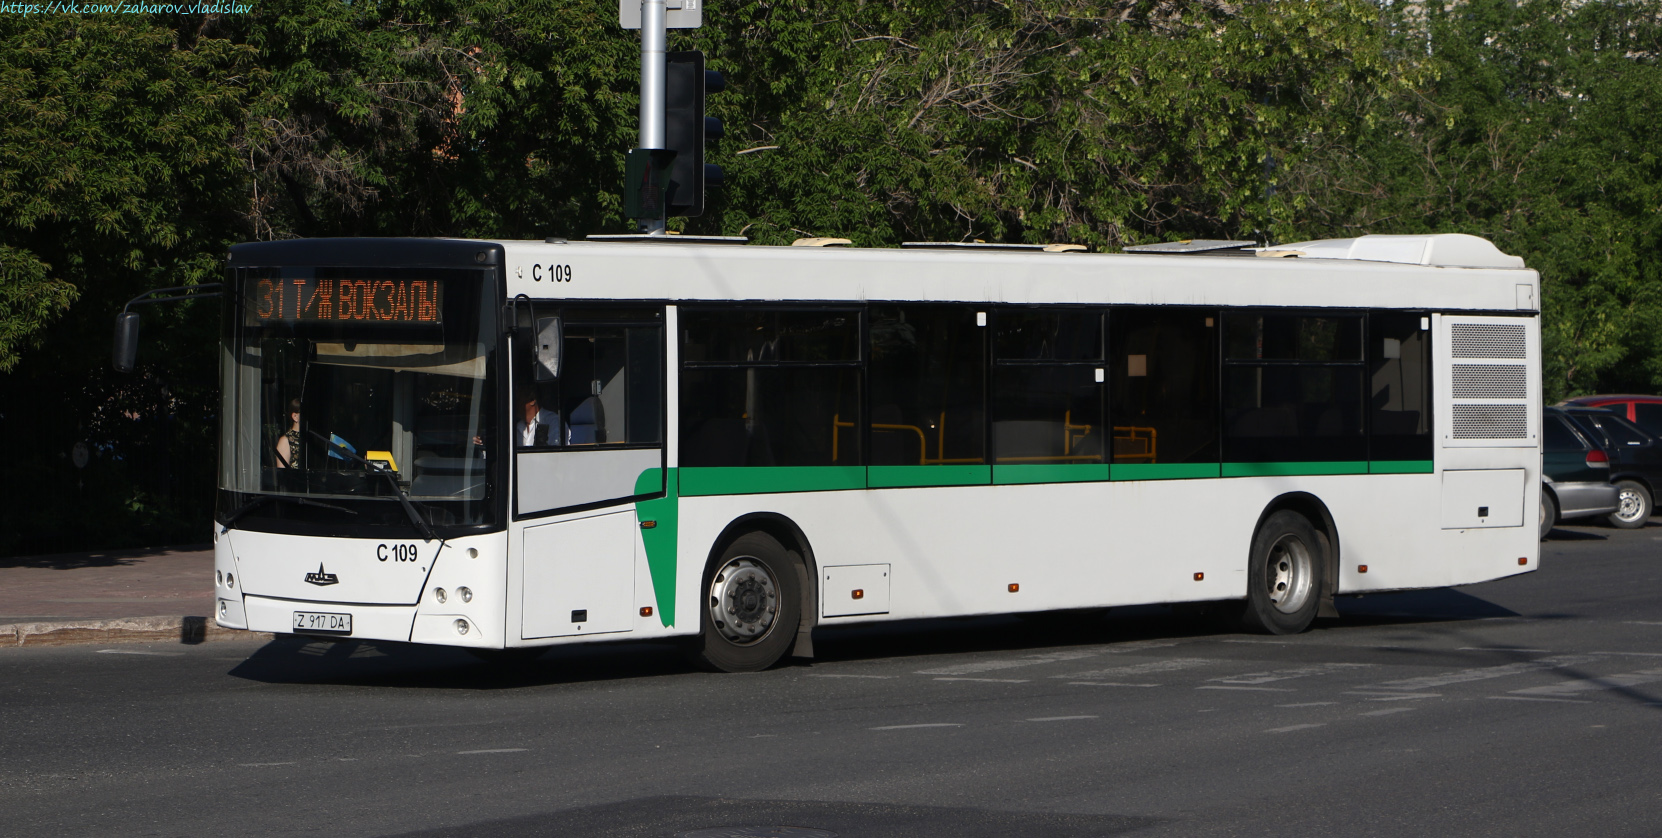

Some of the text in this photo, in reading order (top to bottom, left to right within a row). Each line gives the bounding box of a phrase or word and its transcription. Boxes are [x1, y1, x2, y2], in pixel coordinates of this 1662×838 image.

[548, 264, 572, 282] 109
[257, 278, 284, 319] 31
[338, 279, 438, 321] ВОКЗАЛЫ
[391, 544, 418, 562] 109
[297, 614, 345, 629] Z 917 DA
